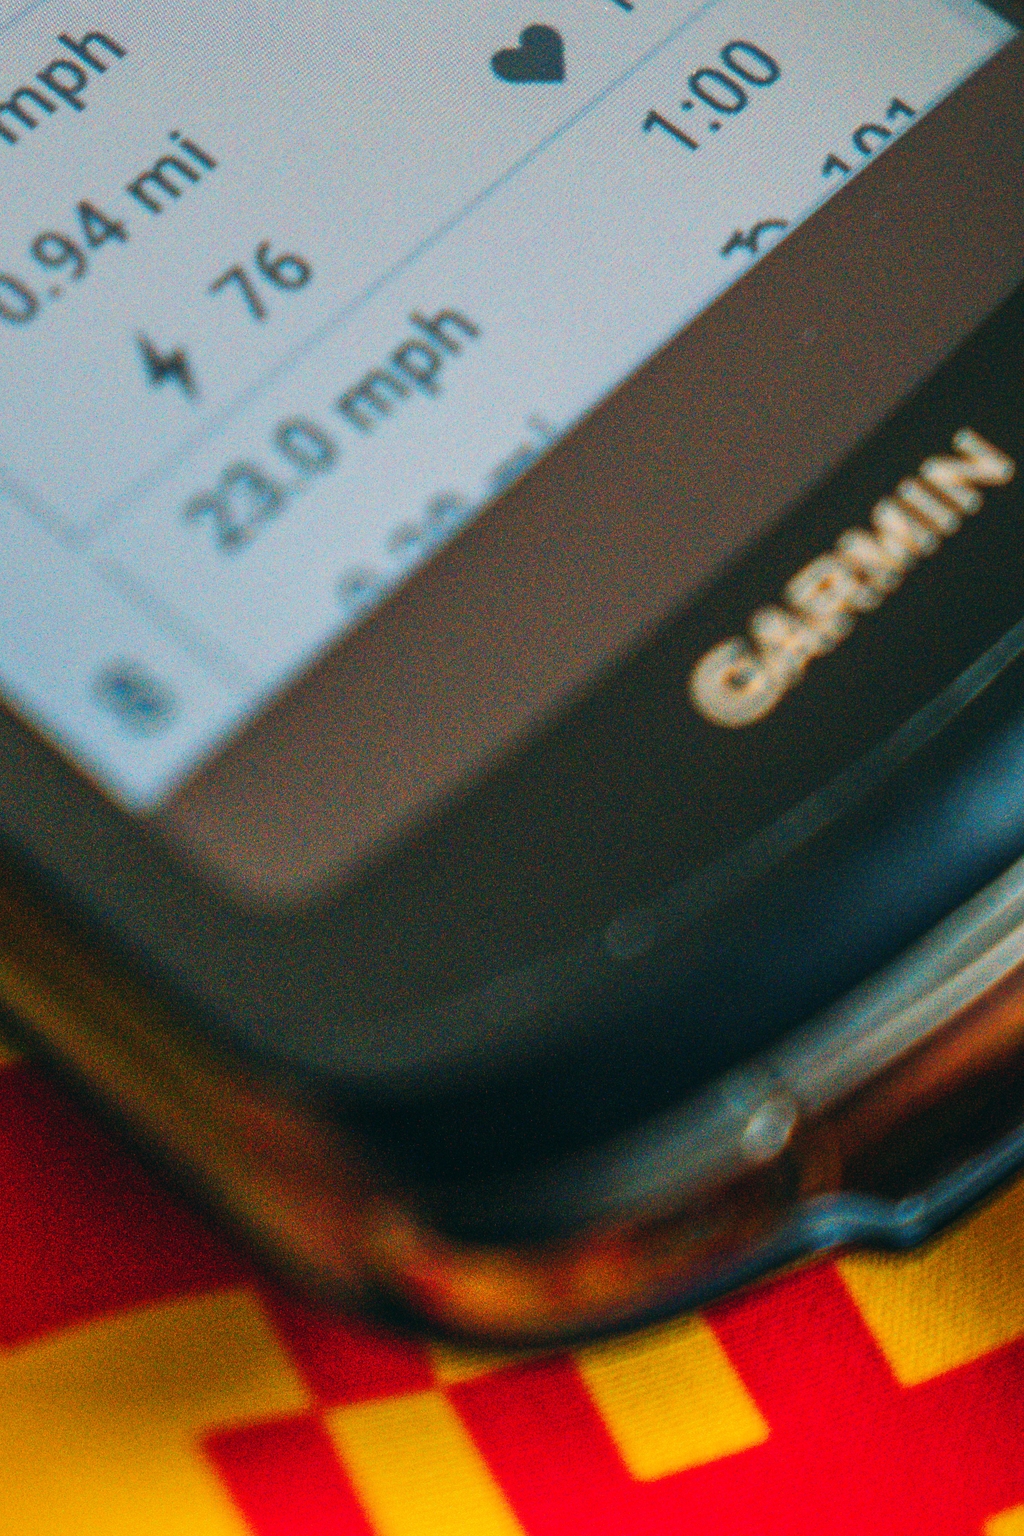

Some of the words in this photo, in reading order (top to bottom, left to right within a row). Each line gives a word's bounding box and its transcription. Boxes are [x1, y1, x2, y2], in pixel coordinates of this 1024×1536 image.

[642, 38, 782, 152] 1:00
[126, 129, 219, 214] mi
[208, 239, 314, 323] 76
[183, 416, 340, 556] 23.0
[335, 306, 482, 434] mph
[687, 426, 1016, 729] GARMIN
